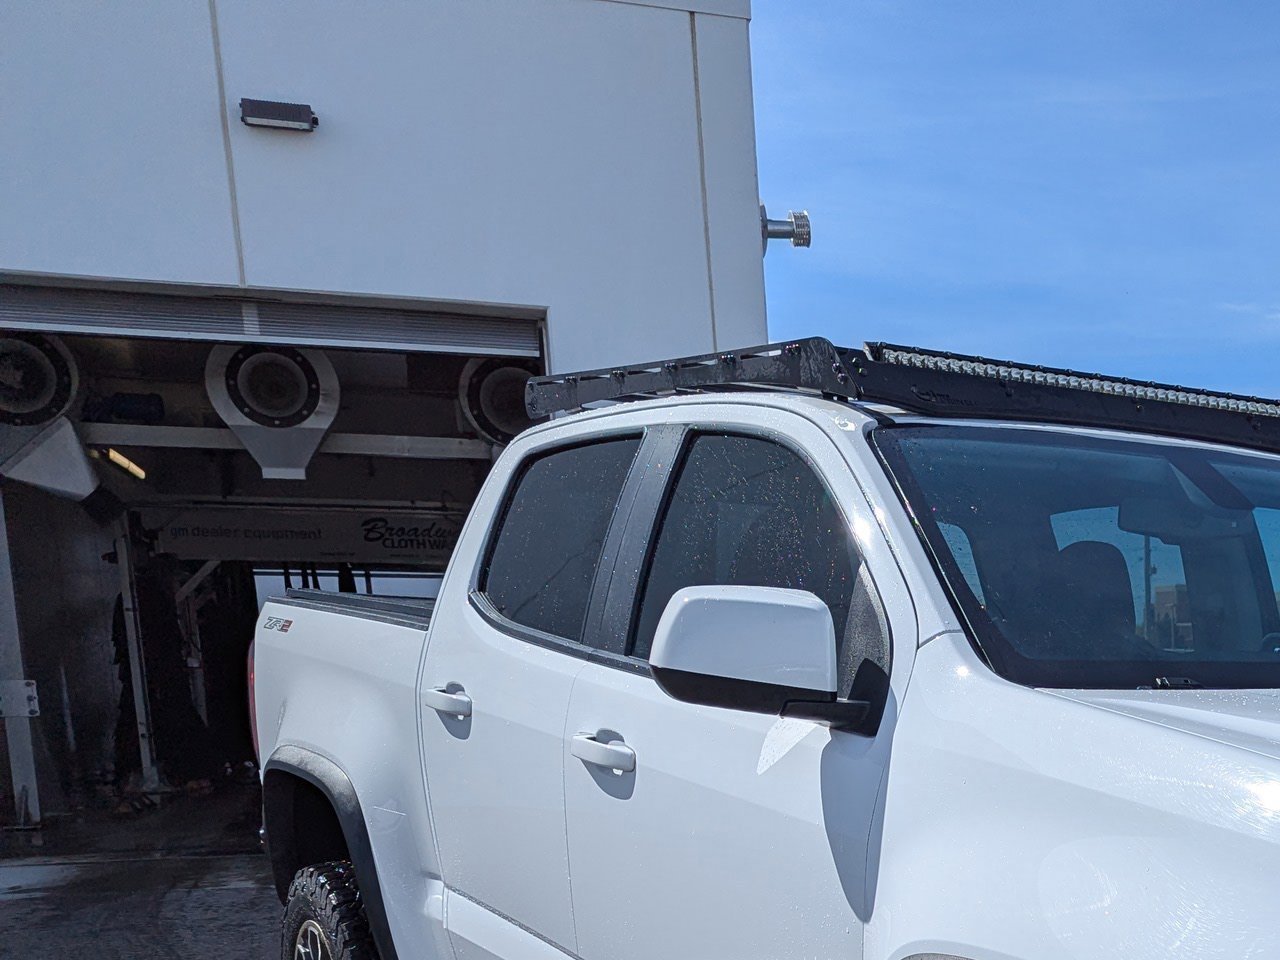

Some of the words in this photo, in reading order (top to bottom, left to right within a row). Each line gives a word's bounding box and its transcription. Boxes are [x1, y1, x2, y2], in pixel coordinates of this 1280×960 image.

[170, 527, 189, 539] gm
[191, 526, 241, 538] dealer
[243, 527, 322, 540] equipment
[263, 616, 293, 633] ZR2
